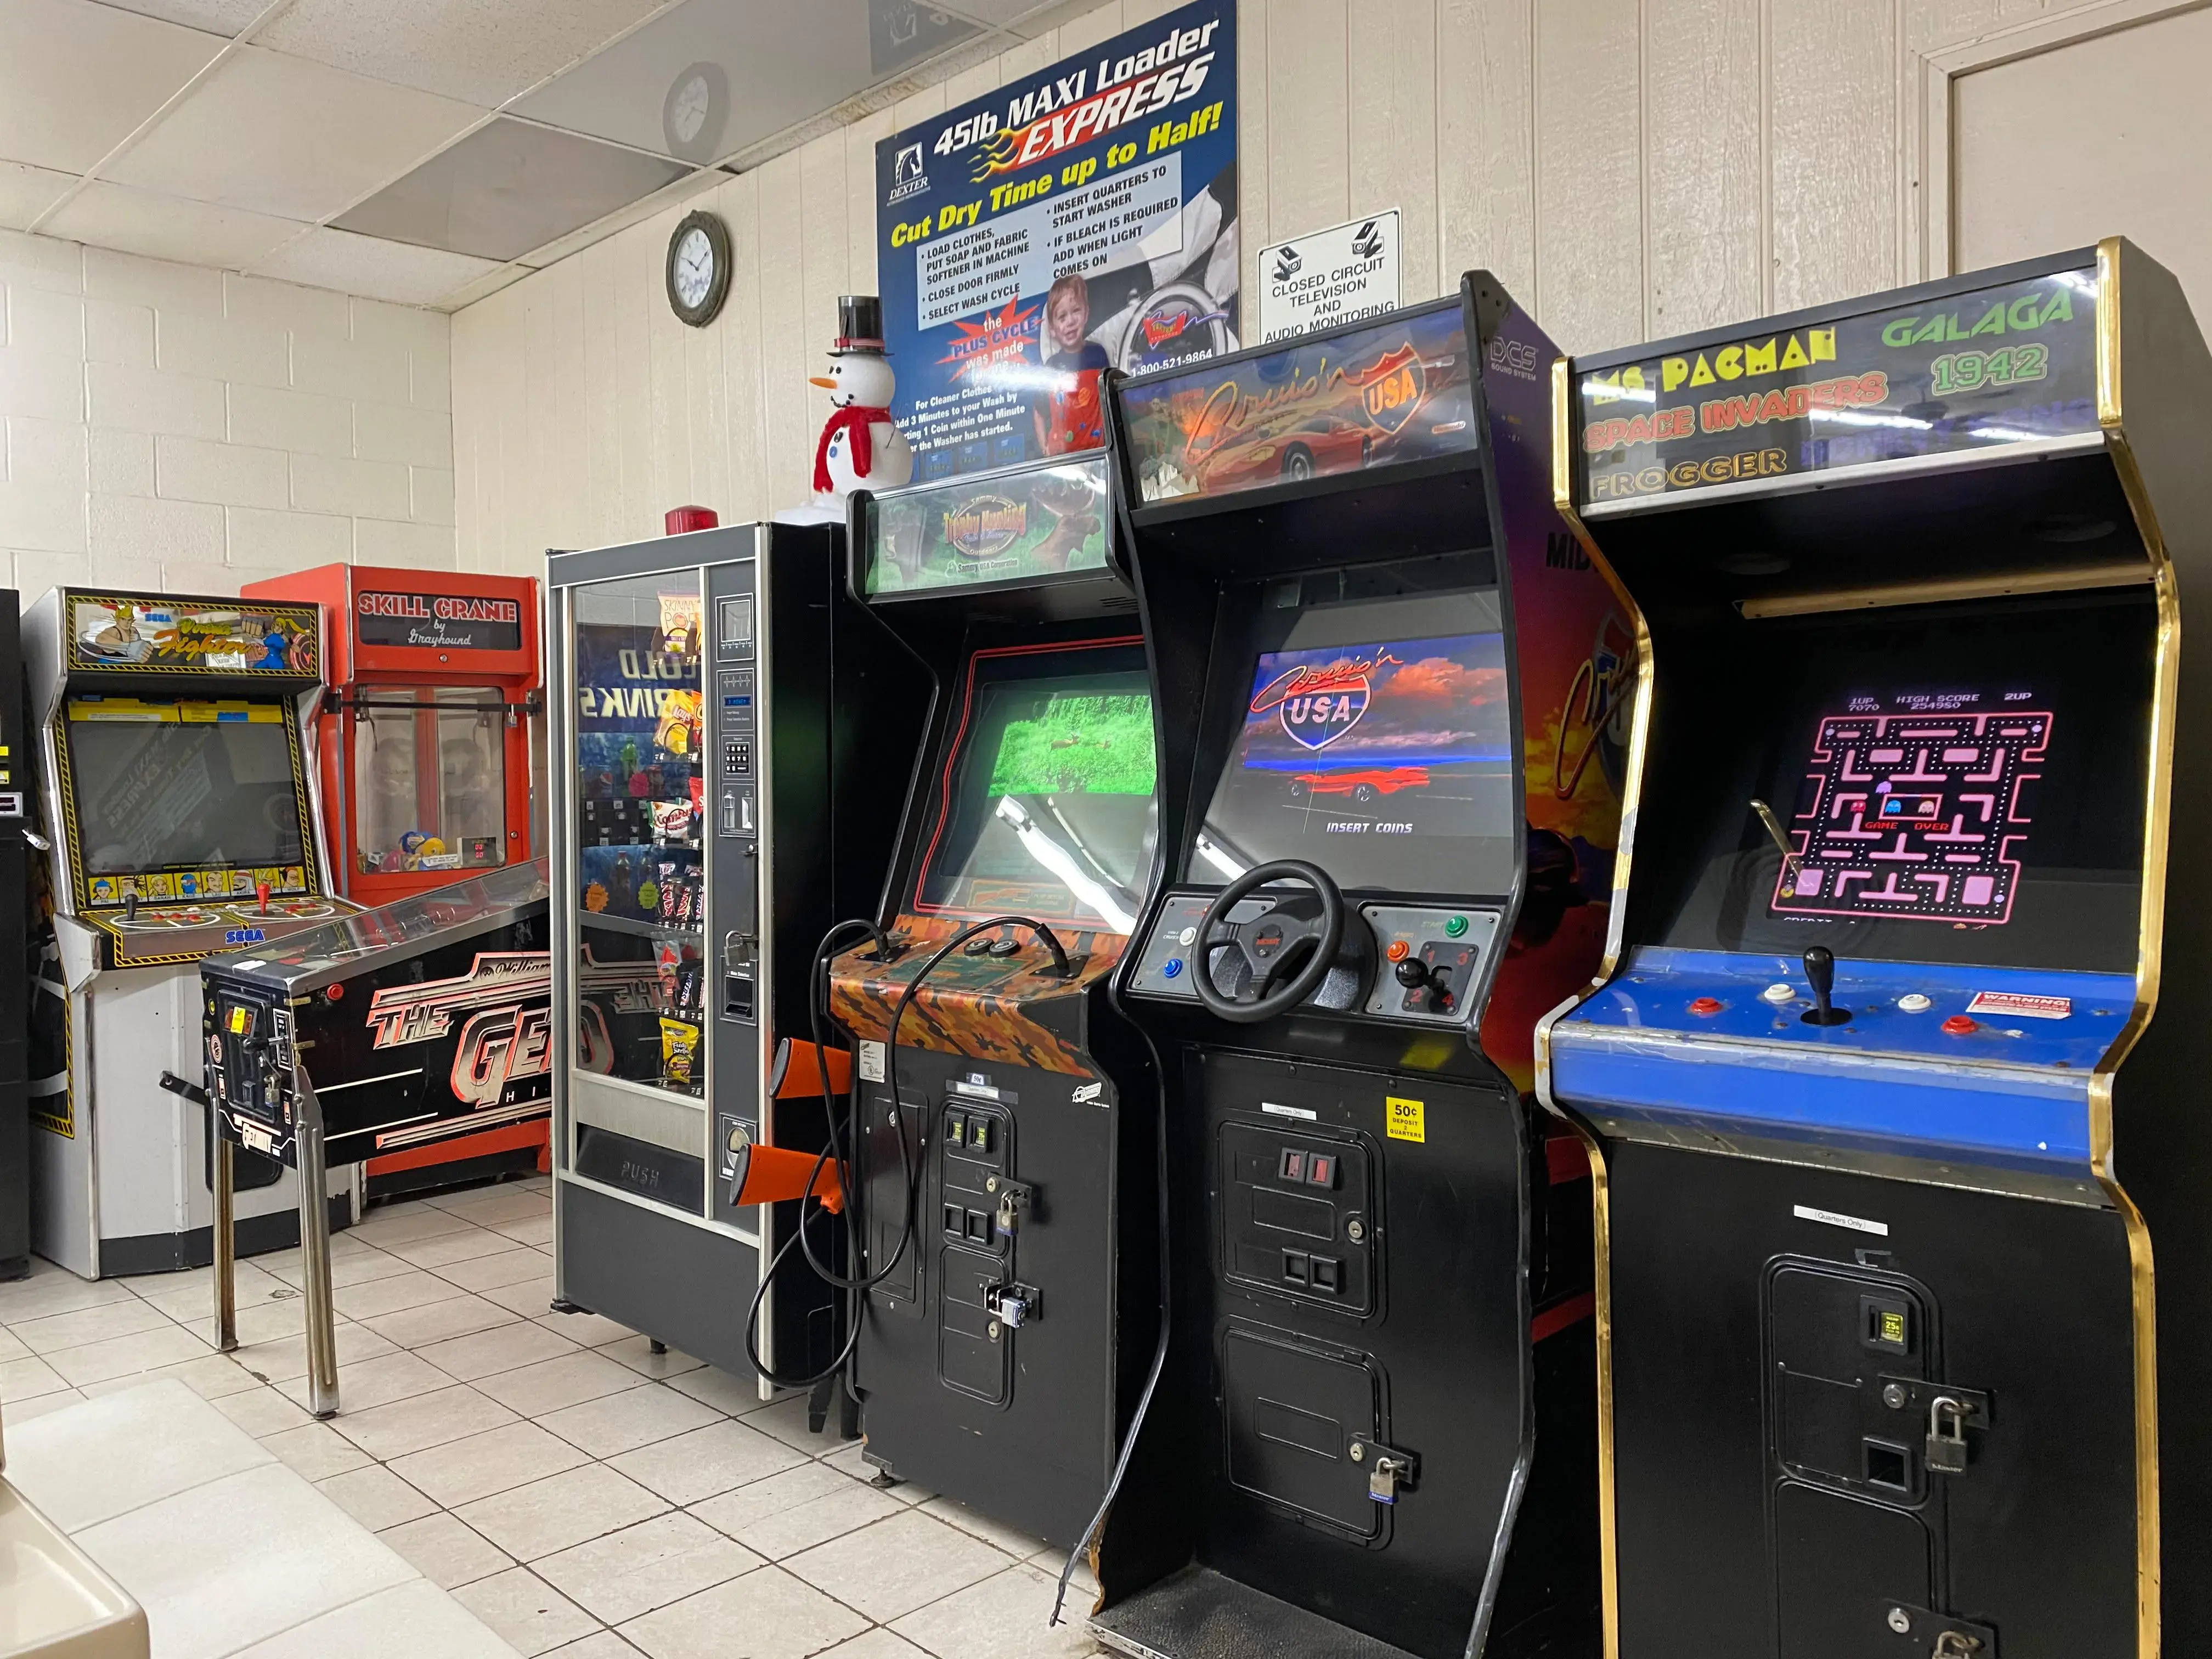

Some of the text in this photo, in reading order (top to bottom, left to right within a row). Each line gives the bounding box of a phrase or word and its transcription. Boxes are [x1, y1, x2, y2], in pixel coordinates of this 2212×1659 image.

[934, 20, 1219, 155] 45lb MAXI Loader
[1017, 52, 1215, 164] EXPRESS
[889, 177, 928, 200] DEXTER
[891, 101, 1224, 247] Cut Dry Time up to Half!
[1054, 165, 1167, 214] INSERT QUARTERS TO
[1053, 192, 1132, 228] START WASHER
[1054, 196, 1178, 247] IF BLEACH IS REQUIRED
[927, 228, 995, 259] LOAD CLOTHES,
[927, 228, 1028, 273] PUT SOAP AND FABRIC
[1053, 225, 1143, 264] ADD WHEN LIGHT
[927, 241, 1030, 285] SOFTENER IN MACHINE
[1053, 253, 1108, 279] COMES ON
[1272, 257, 1385, 298] CLOSED CIRCUIT
[928, 263, 1019, 302] CLOSE DOOR FIRMLY
[1289, 278, 1367, 308] TELEVISION
[928, 283, 1020, 320] SELECT WASH CYCLE
[1313, 300, 1341, 317] AND
[983, 317, 1002, 332] the
[1265, 301, 1395, 343] AUDIO MONITORING
[1880, 289, 2074, 347] GALAGA
[952, 315, 1040, 358] PLUS CYCLE
[966, 340, 1024, 369] was made
[1132, 348, 1213, 377] 1-800-521-9864
[1489, 336, 1537, 372] DCS
[1662, 326, 1837, 393] PACMAN
[1491, 362, 1536, 381] SOUND SYSTEM
[1931, 343, 2048, 397] 1942
[915, 385, 992, 411] For Cleaner Clothes
[1368, 368, 1418, 416] USA
[895, 391, 1018, 428] Add 3 Minutes to your Wash by
[923, 426, 928, 436] 1
[931, 422, 949, 435] Coin
[950, 416, 975, 430] within
[977, 413, 994, 424] One
[996, 405, 1025, 419] Minute
[1583, 406, 1696, 453] SPACE
[1702, 371, 1889, 435] INVADERS
[919, 441, 932, 451] the
[933, 433, 963, 448] Washer
[964, 430, 979, 441] has
[981, 421, 1013, 436] started.
[1590, 448, 1788, 500] FROGGER
[957, 563, 978, 573] Sammy
[145, 613, 172, 623] SEGA
[357, 594, 517, 623] SKILL CRANE
[664, 598, 698, 612] SKINNY
[433, 619, 446, 631] by
[153, 627, 252, 662] Fighter
[1249, 646, 1404, 713] Cruis'n
[1290, 695, 1351, 724] USA
[2004, 692, 2032, 701] 2UP
[1326, 822, 1413, 833] INSERT COINS
[1914, 822, 1949, 831] OVER
[225, 929, 266, 945] SEGA
[495, 959, 551, 980] William
[1427, 950, 1469, 966] 1 3
[1410, 989, 1453, 1006] 2 4
[365, 1003, 453, 1049] THE
[450, 1004, 551, 1110] GE
[1392, 1117, 1418, 1126] DEPOSIT
[1395, 1104, 1418, 1118] 50¢
[1390, 1129, 1422, 1138] QUARTERS
[621, 1160, 660, 1189] PUSH
[1932, 1463, 1963, 1473] Master
[1372, 1492, 1391, 1502] Master
